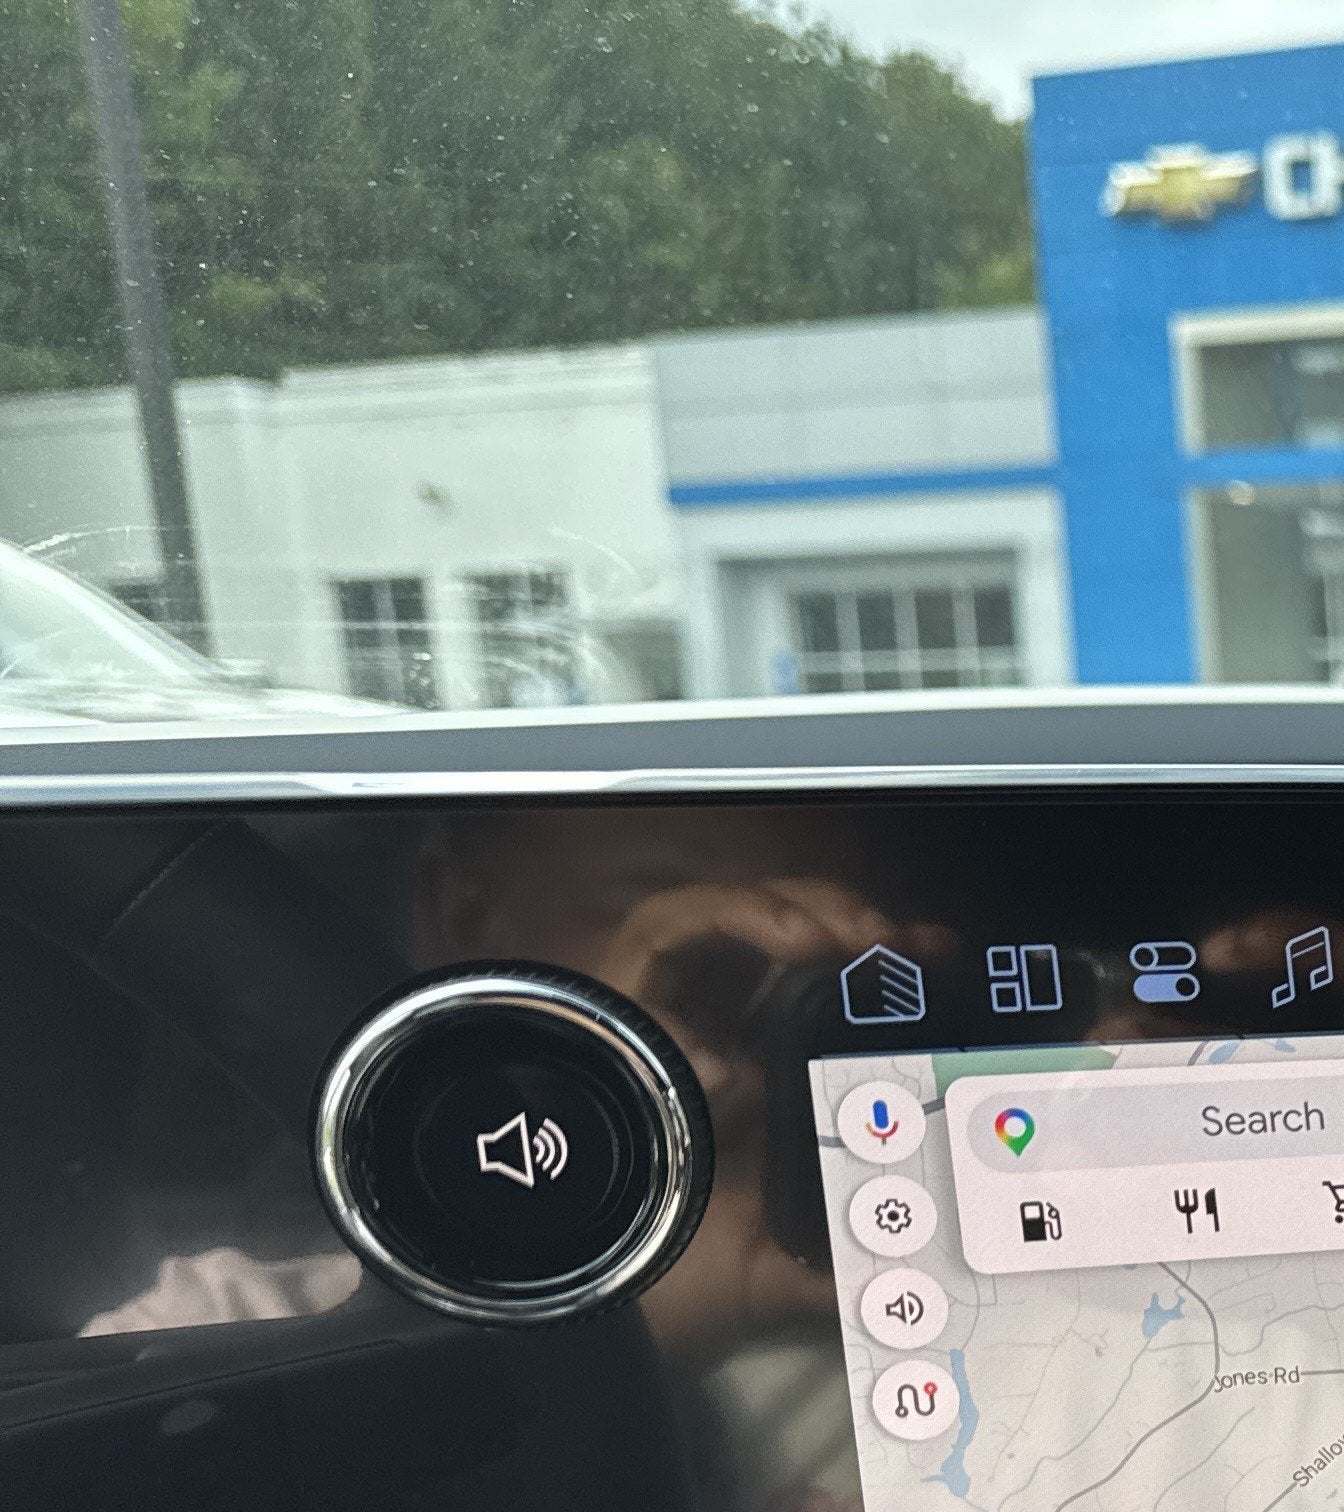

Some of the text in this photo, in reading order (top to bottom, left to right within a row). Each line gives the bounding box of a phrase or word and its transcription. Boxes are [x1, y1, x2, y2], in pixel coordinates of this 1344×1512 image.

[1202, 1101, 1326, 1137] Search
[1214, 1366, 1301, 1393] Jones Rd
